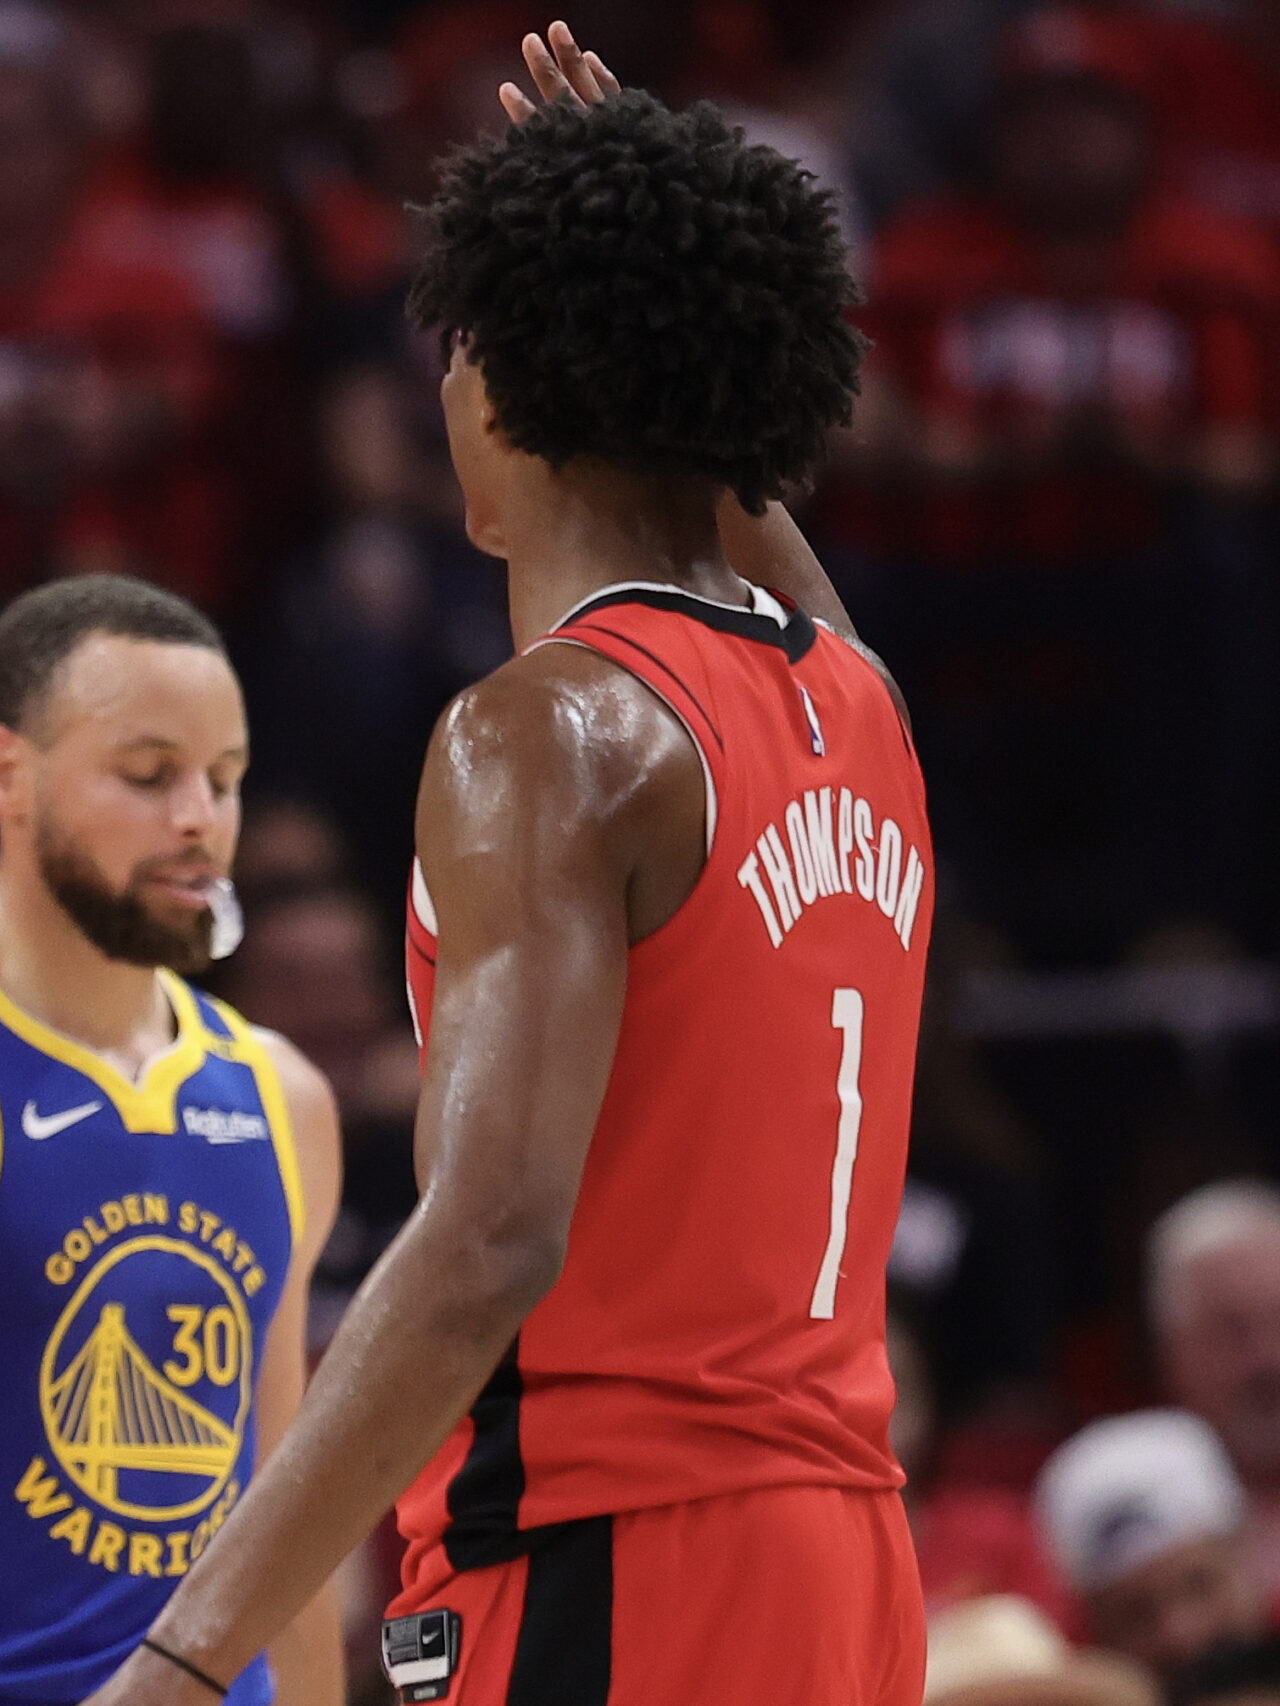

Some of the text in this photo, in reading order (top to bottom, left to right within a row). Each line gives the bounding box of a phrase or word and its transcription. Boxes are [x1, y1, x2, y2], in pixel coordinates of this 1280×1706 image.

[737, 786, 924, 952] THOMPSON
[809, 987, 864, 1320] 1
[44, 1192, 268, 1297] GOLDEN STATE
[163, 1303, 239, 1387] 30
